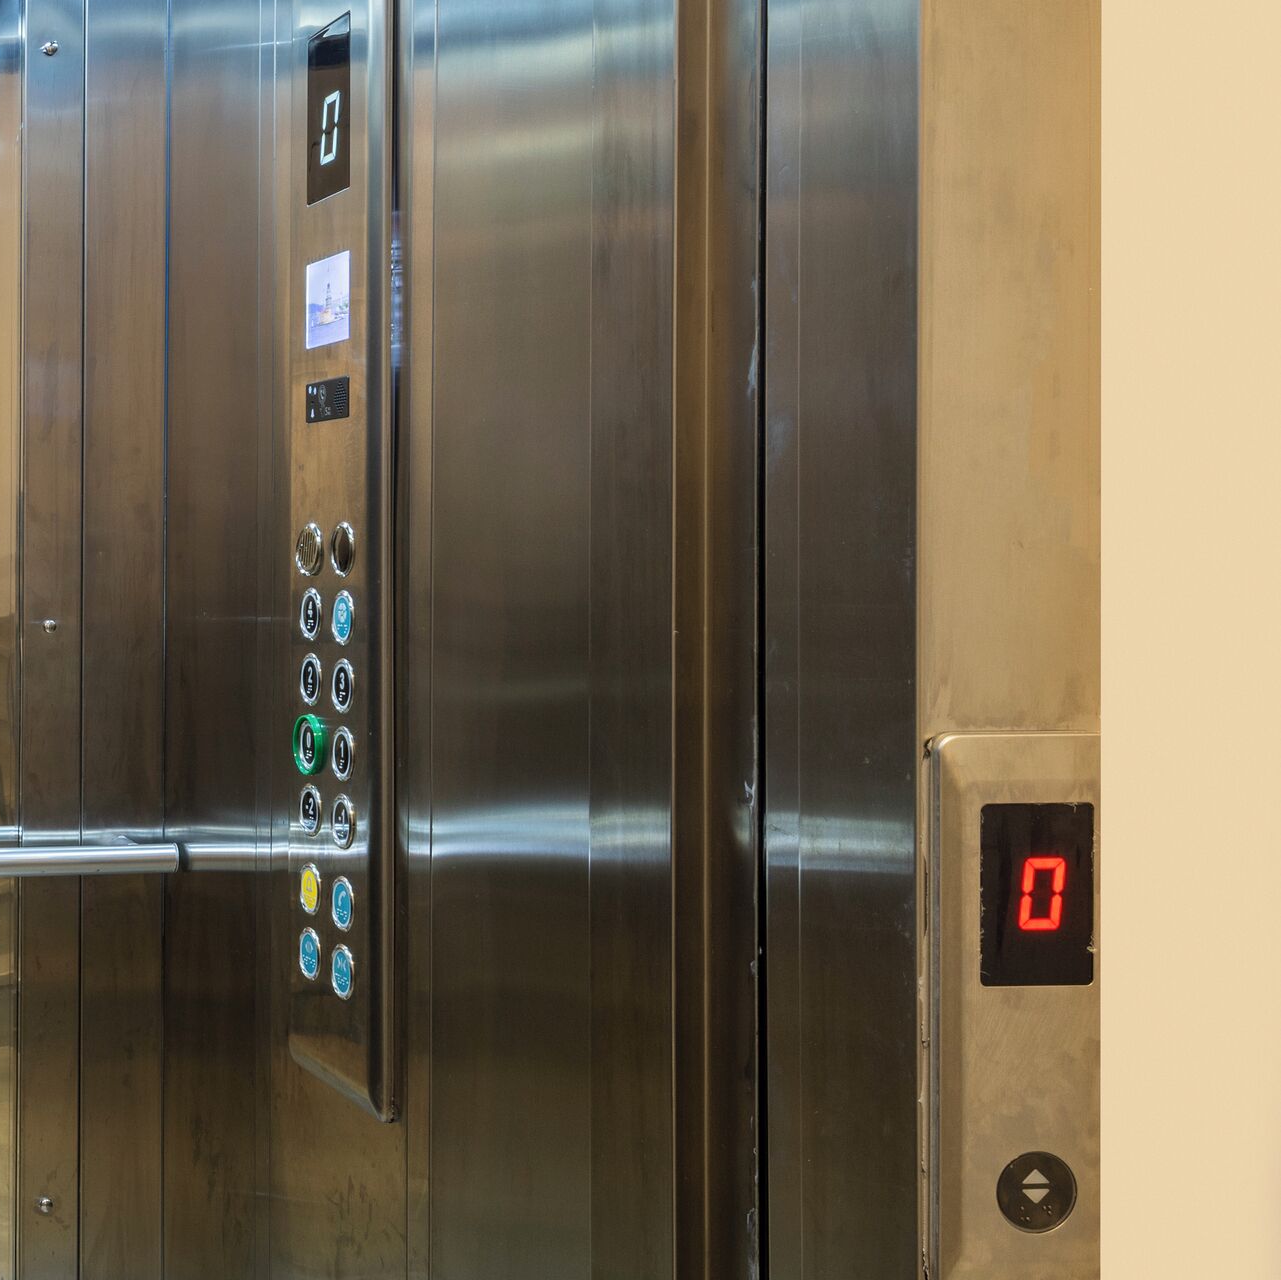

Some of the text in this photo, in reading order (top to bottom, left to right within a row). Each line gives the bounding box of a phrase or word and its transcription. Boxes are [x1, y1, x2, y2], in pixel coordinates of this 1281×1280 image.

[320, 89, 341, 166] 0
[307, 666, 313, 684] 2
[339, 672, 345, 690] 3
[306, 731, 311, 748] 0
[340, 740, 344, 758] 1
[1019, 857, 1066, 931] 0
